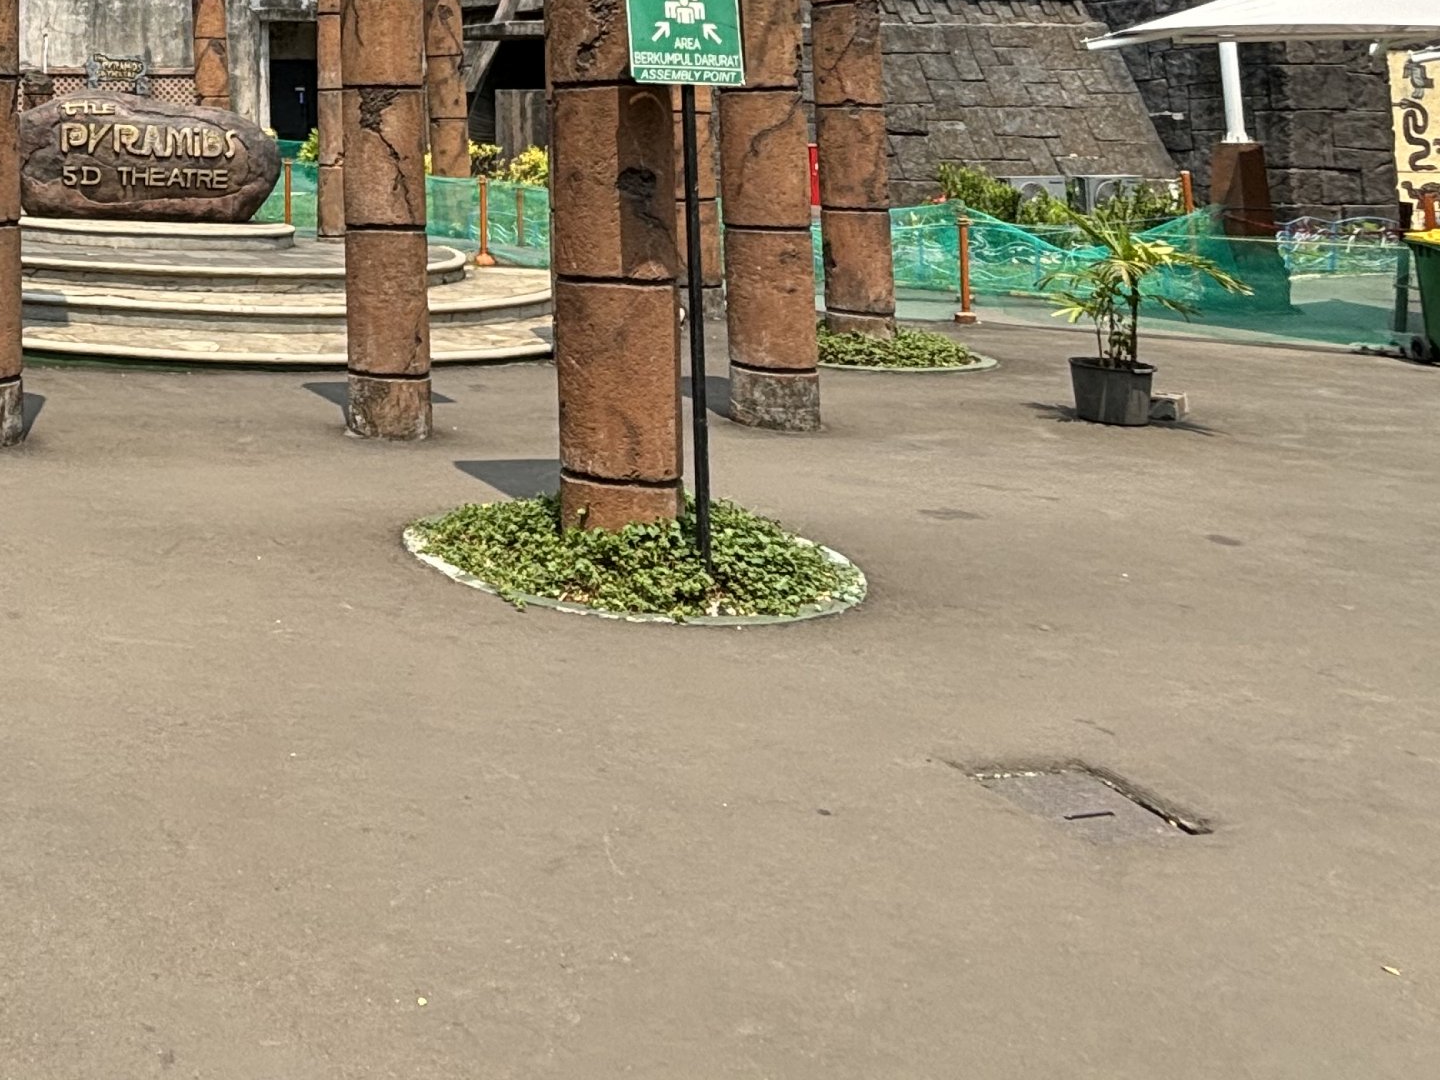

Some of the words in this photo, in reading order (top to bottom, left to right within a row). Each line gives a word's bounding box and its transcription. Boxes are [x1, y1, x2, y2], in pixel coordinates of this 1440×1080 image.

[674, 37, 701, 50] AREA
[634, 51, 693, 66] BERKUMPUL
[694, 54, 739, 67] DARURAT
[641, 69, 701, 81] ASSEMBLY
[703, 72, 737, 82] POINT
[62, 166, 101, 186] 5D
[117, 166, 229, 189] THEATRE
